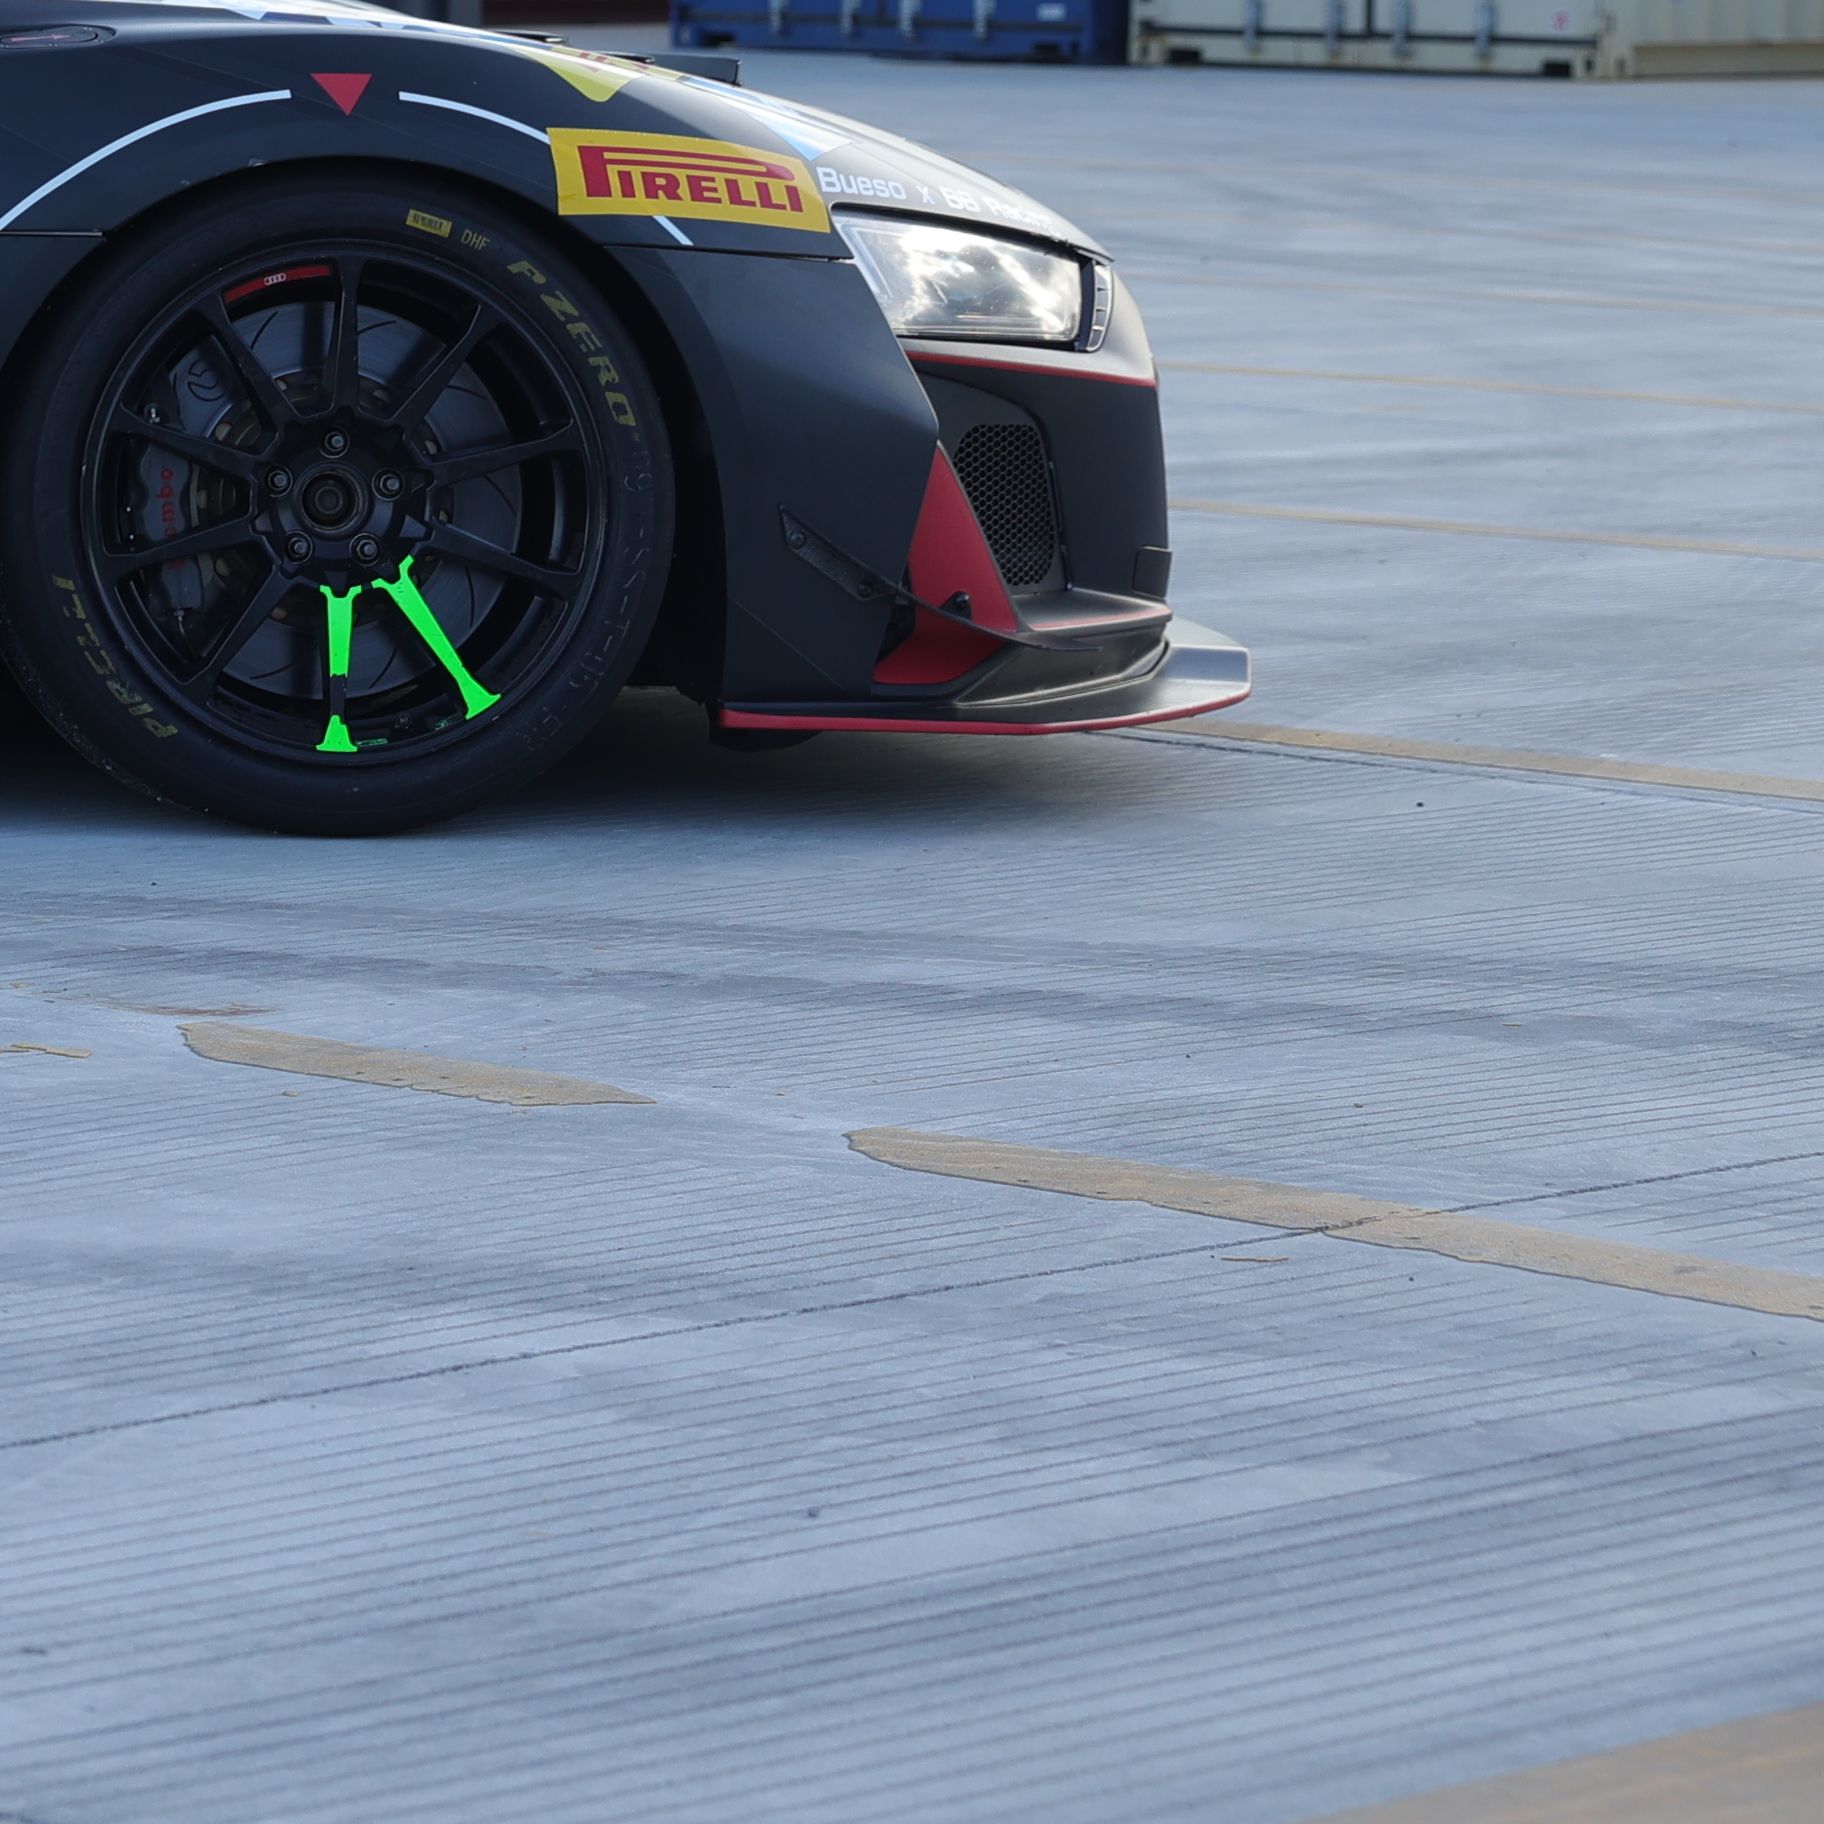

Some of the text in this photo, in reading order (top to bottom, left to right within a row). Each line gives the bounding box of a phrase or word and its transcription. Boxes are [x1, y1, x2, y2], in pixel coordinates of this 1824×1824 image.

[577, 144, 804, 213] PIRELLI
[816, 166, 907, 200] Bueso
[460, 228, 491, 250] DHF
